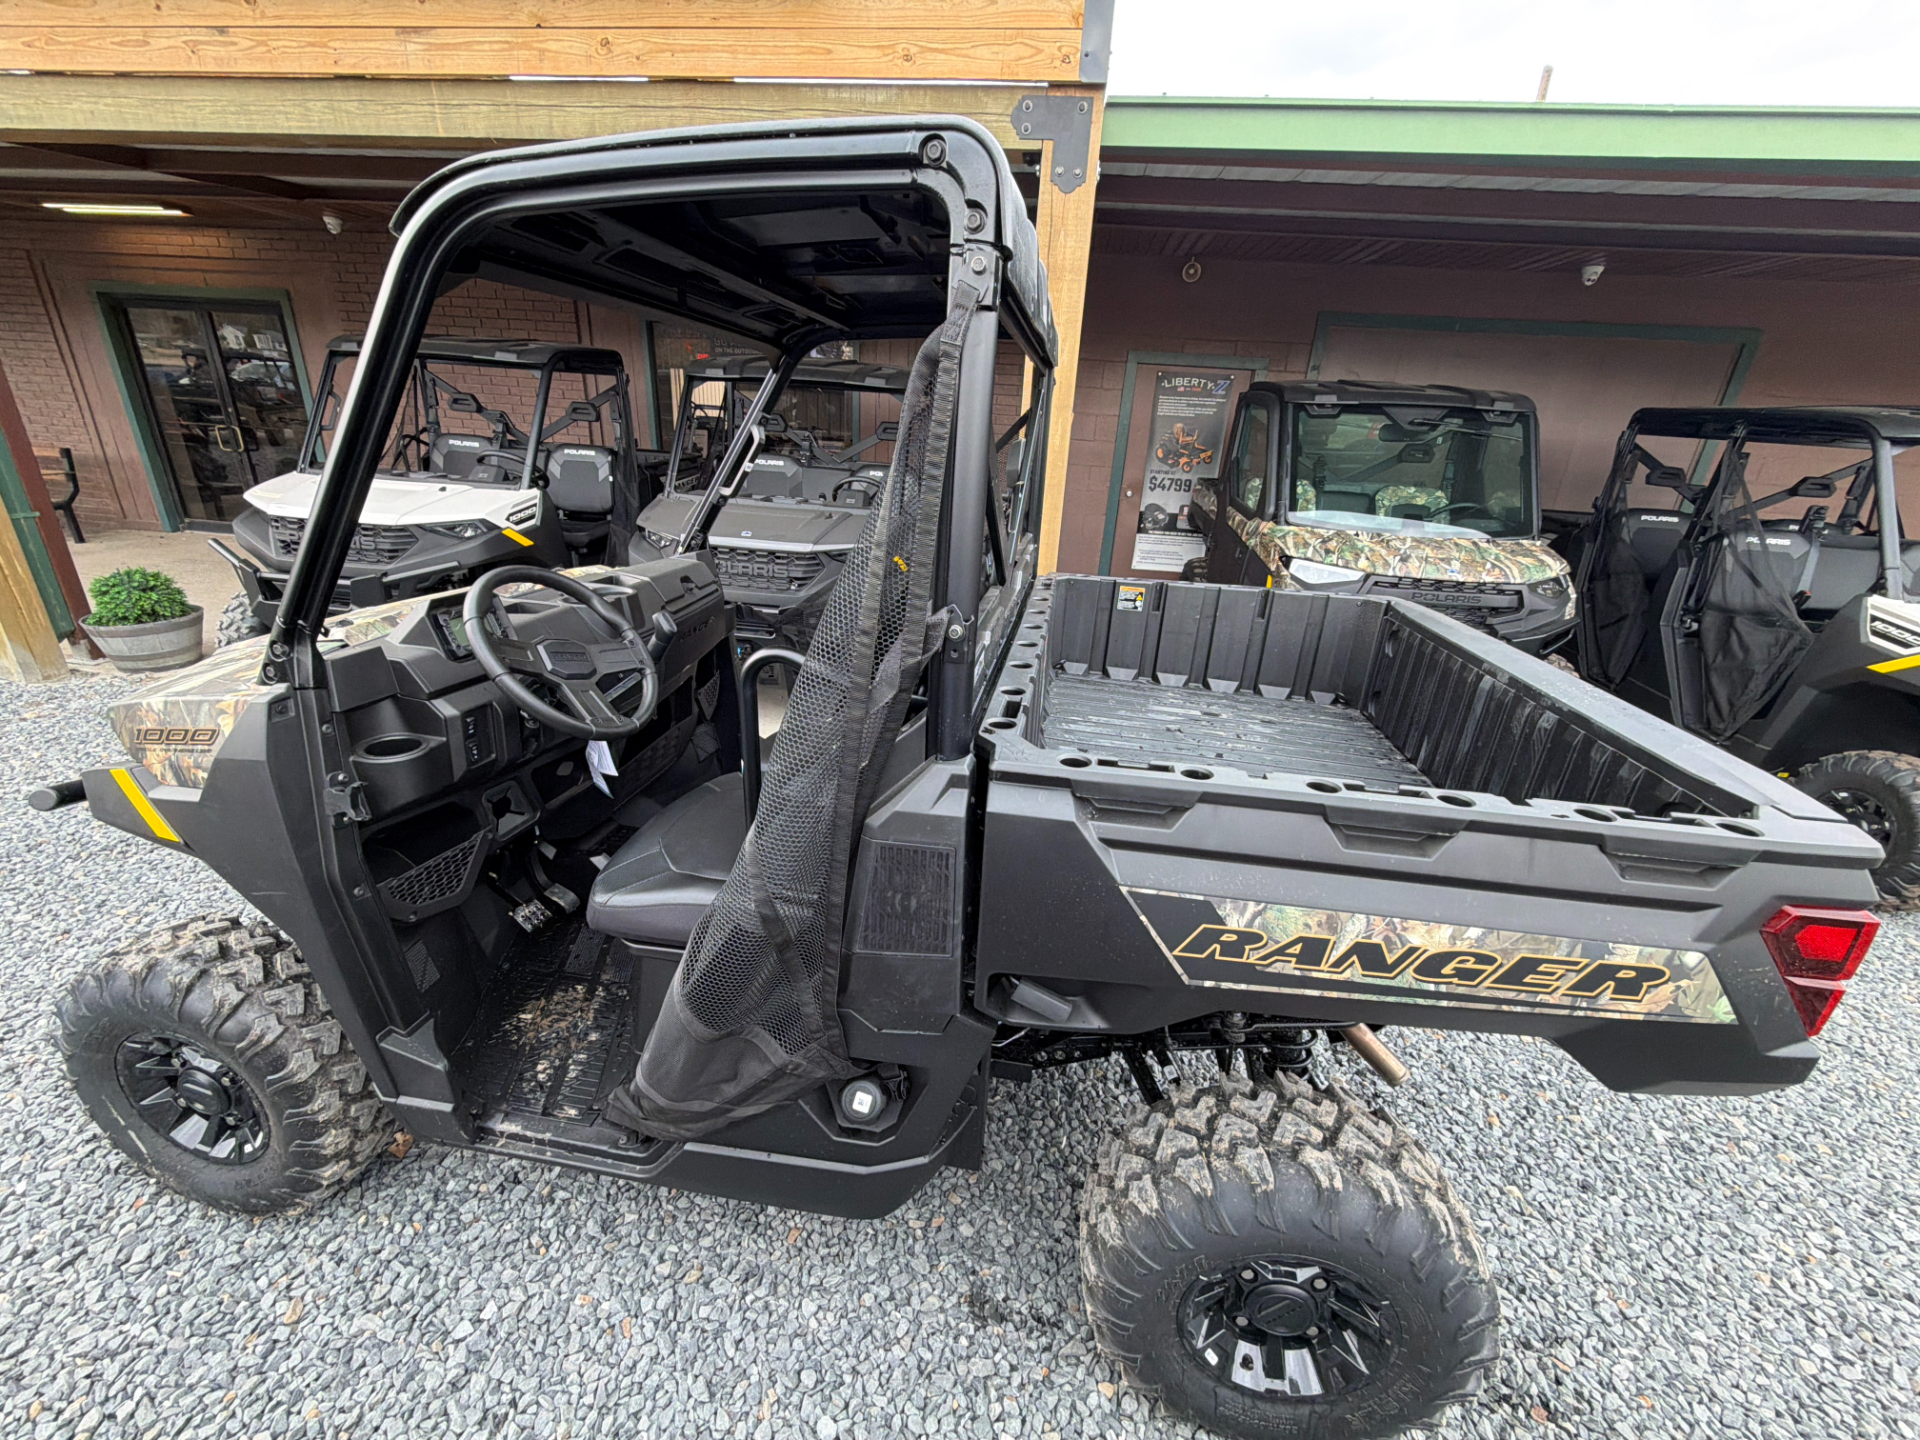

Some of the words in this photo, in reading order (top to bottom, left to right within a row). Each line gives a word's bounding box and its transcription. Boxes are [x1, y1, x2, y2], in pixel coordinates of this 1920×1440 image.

[1164, 377, 1214, 390] LIBERTY
[1149, 475, 1192, 492] $4799
[509, 506, 536, 521] 1000
[716, 560, 788, 577] OLARIS
[1411, 592, 1481, 604] POLARIS
[134, 727, 219, 745] 1000
[1173, 923, 1672, 1001] RANGER
